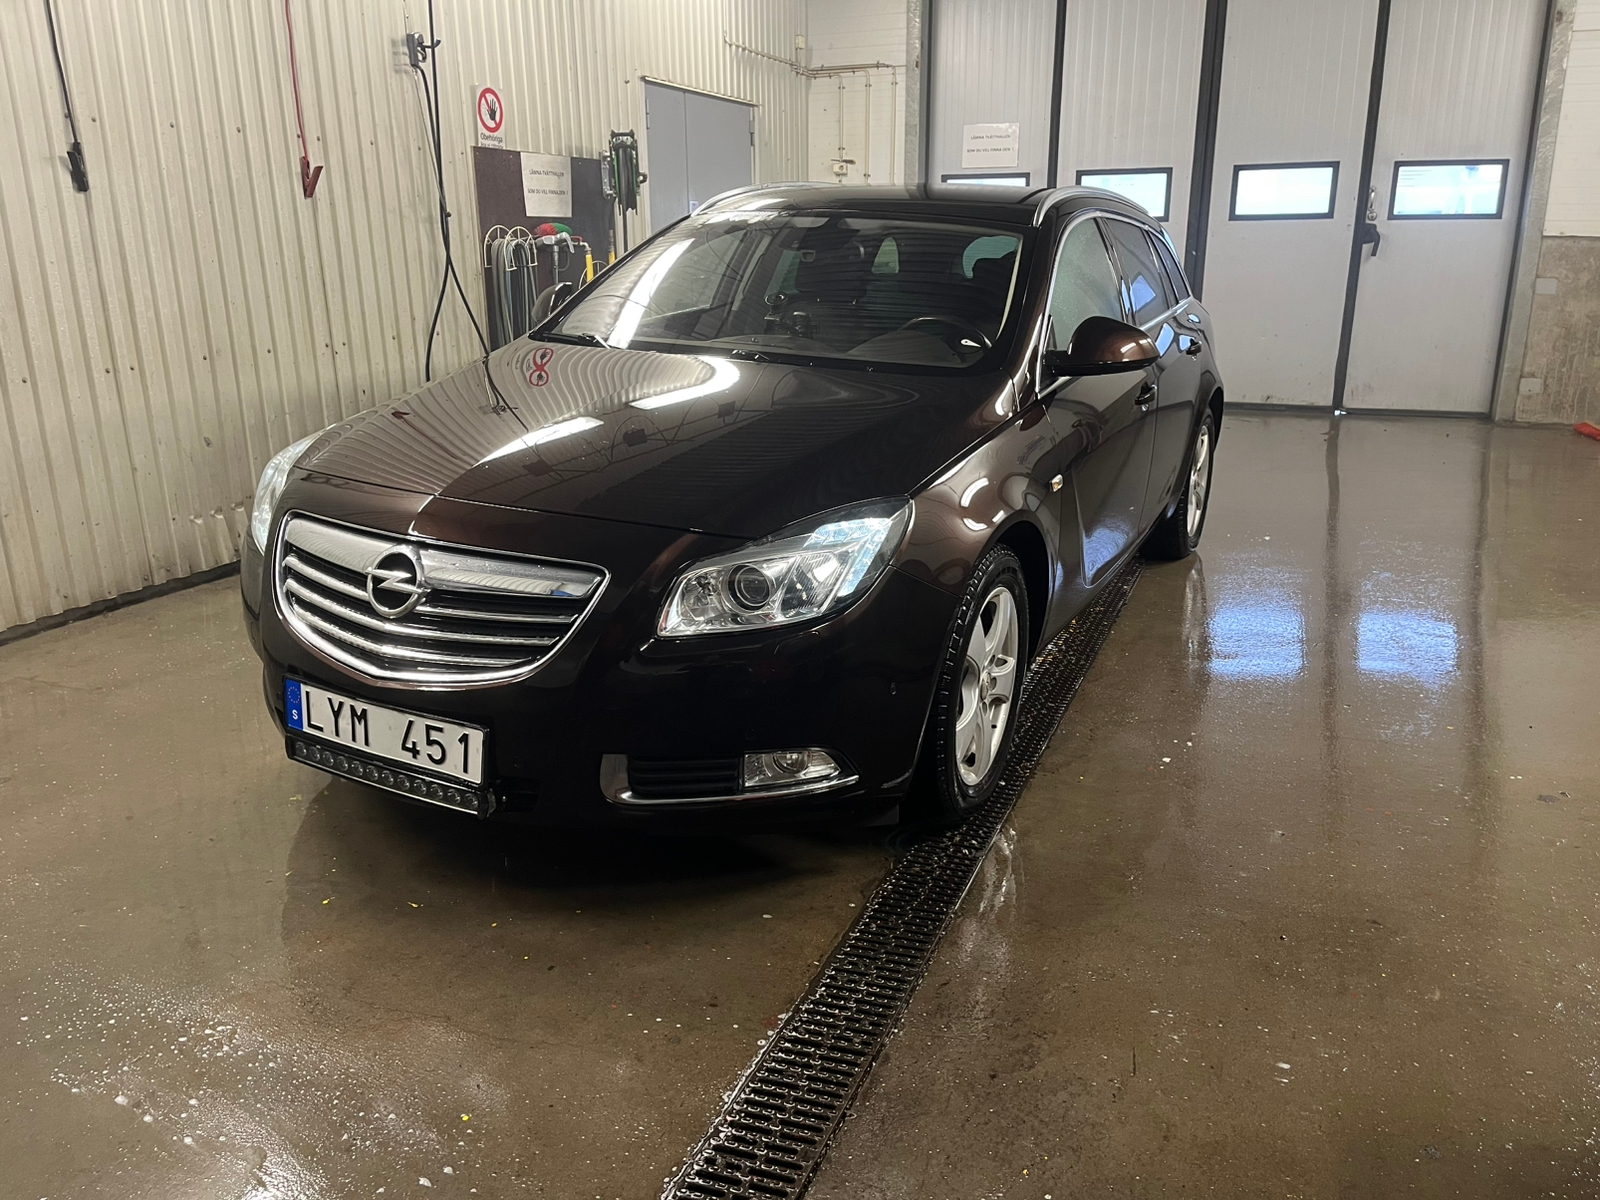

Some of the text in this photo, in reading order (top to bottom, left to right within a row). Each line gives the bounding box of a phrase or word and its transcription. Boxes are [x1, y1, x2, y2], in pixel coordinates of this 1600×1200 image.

[480, 132, 503, 144] Obehöriga
[292, 709, 299, 720] S
[305, 690, 470, 775] LYM 451
